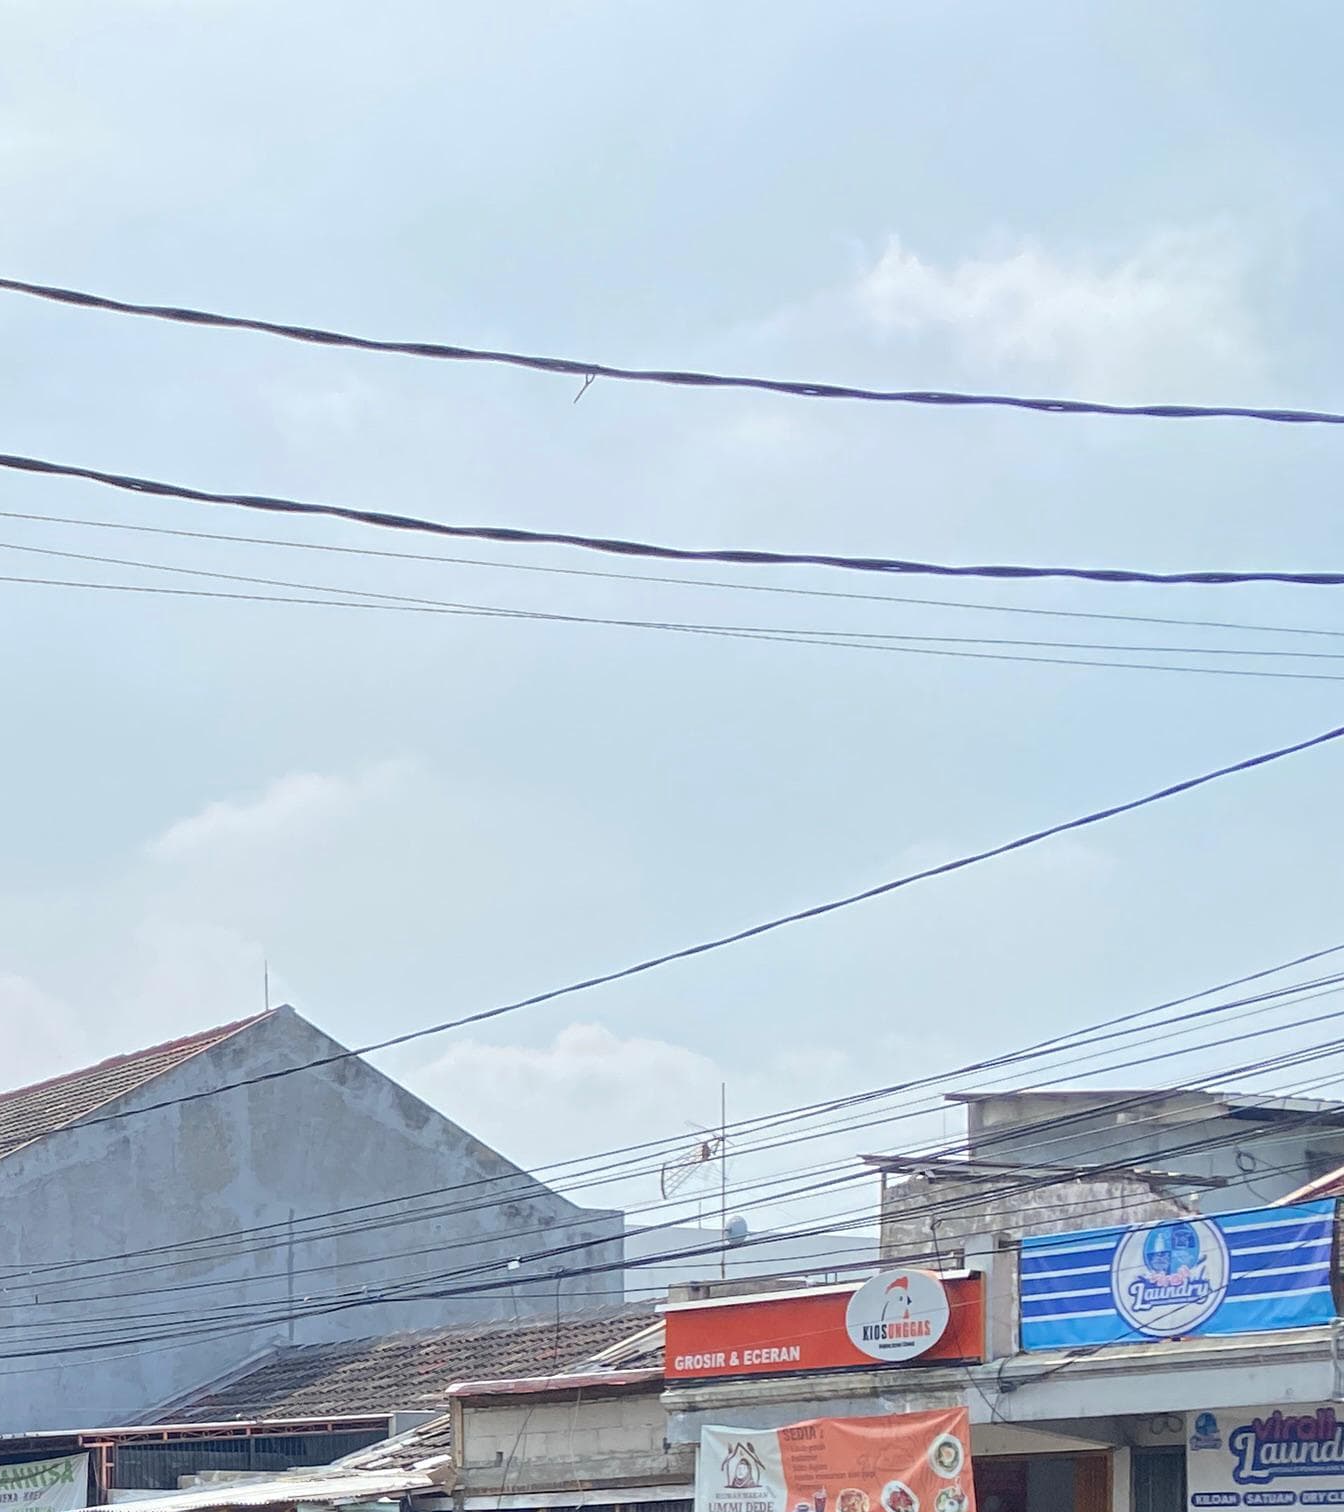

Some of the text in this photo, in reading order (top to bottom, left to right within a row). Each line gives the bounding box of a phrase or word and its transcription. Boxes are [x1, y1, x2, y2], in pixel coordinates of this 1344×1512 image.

[1130, 1270, 1211, 1311] Laundry
[674, 1346, 801, 1371] GROSIR & ECERAN
[1231, 1426, 1344, 1480] Laund
[708, 1502, 775, 1512] UMMI DEDE
[1194, 1494, 1237, 1505] KILOAN
[1245, 1493, 1294, 1504] SATUAN
